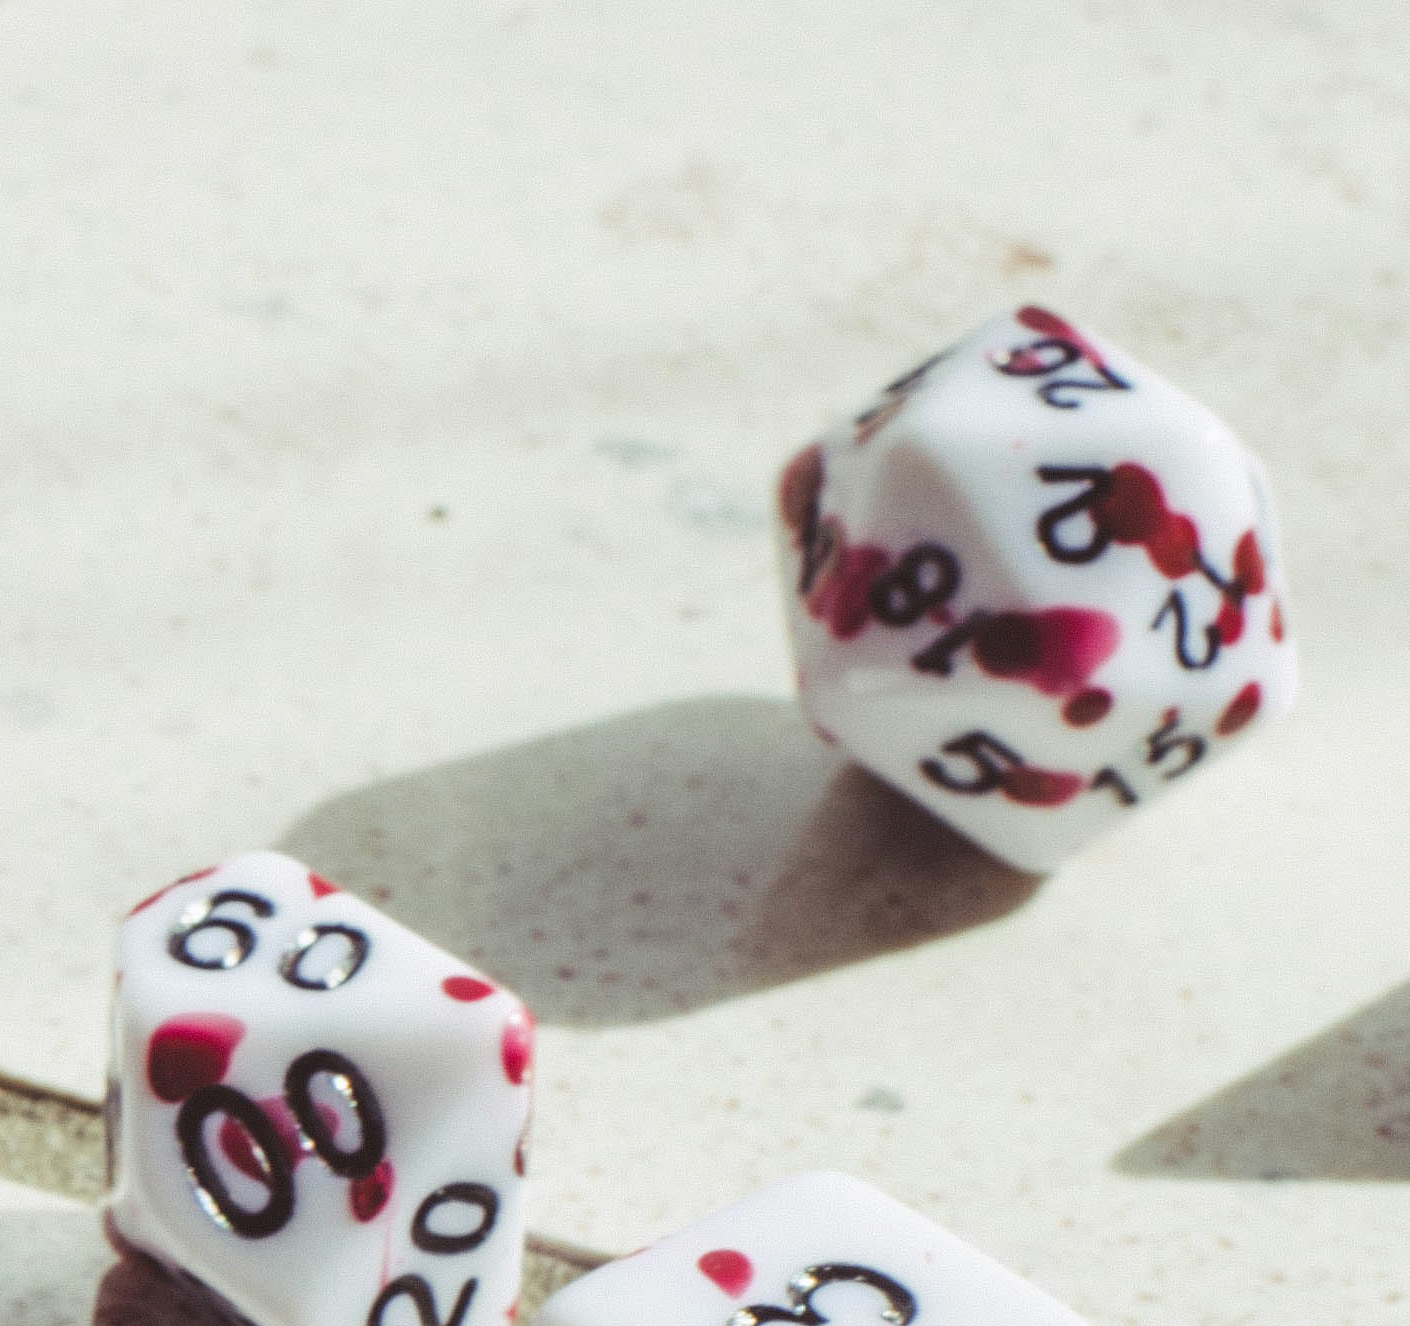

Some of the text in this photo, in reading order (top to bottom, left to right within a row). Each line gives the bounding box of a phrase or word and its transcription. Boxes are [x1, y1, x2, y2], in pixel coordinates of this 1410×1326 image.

[1090, 716, 1207, 806] 15
[168, 889, 370, 991] 60
[177, 1048, 387, 1240] 00
